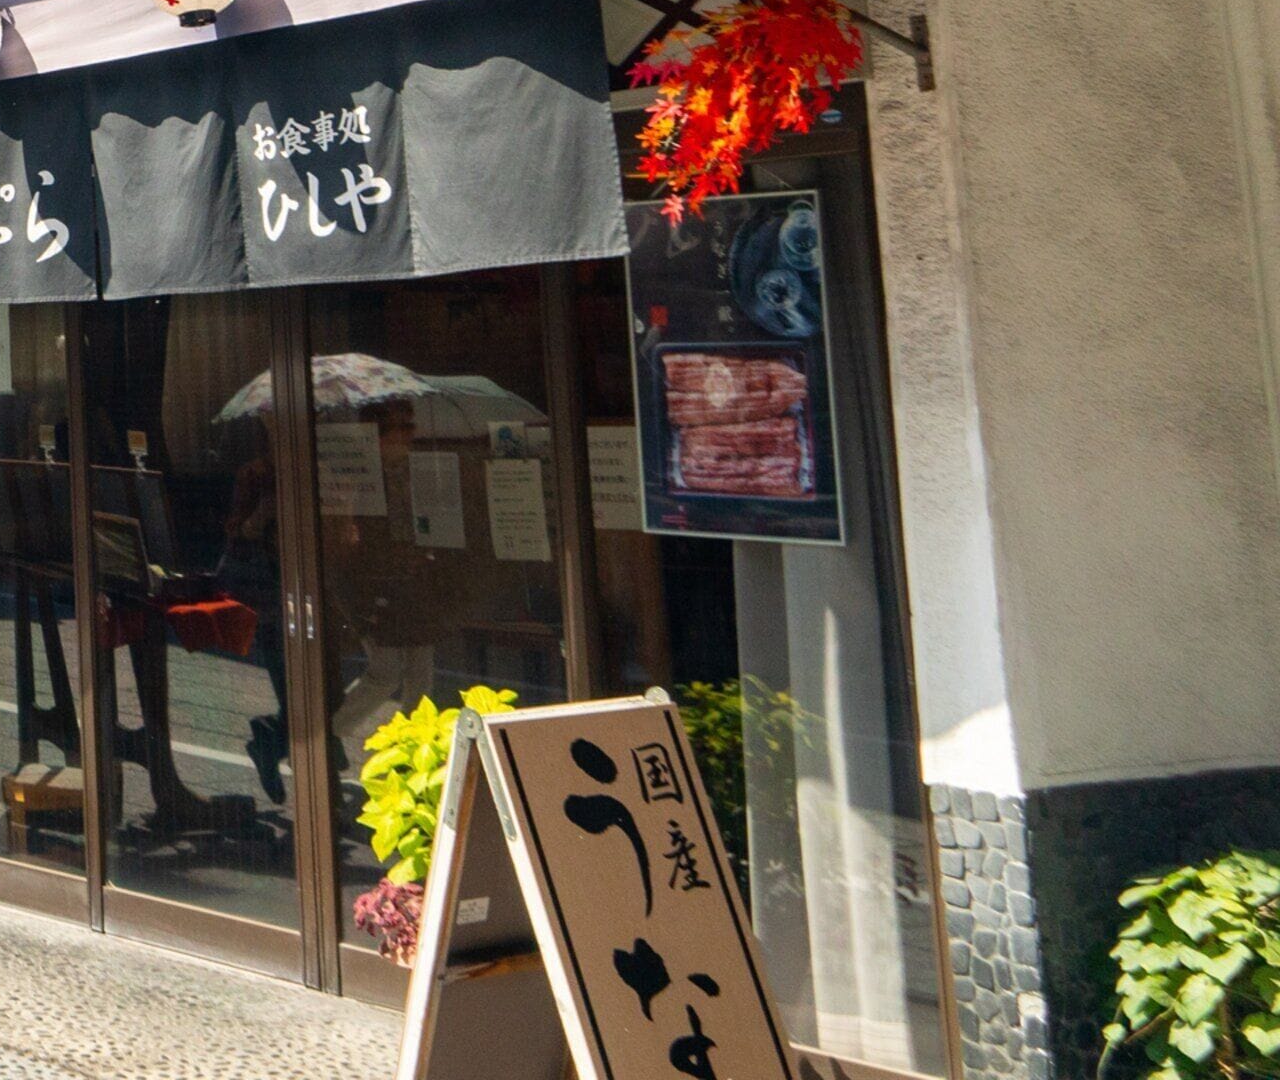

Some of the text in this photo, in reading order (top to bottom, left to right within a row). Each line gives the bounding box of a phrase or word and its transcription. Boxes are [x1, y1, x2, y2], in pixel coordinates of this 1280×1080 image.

[253, 105, 372, 161] お食事処
[257, 164, 392, 242] ひしや
[631, 742, 711, 891] 国産
[564, 738, 721, 1080] うな
